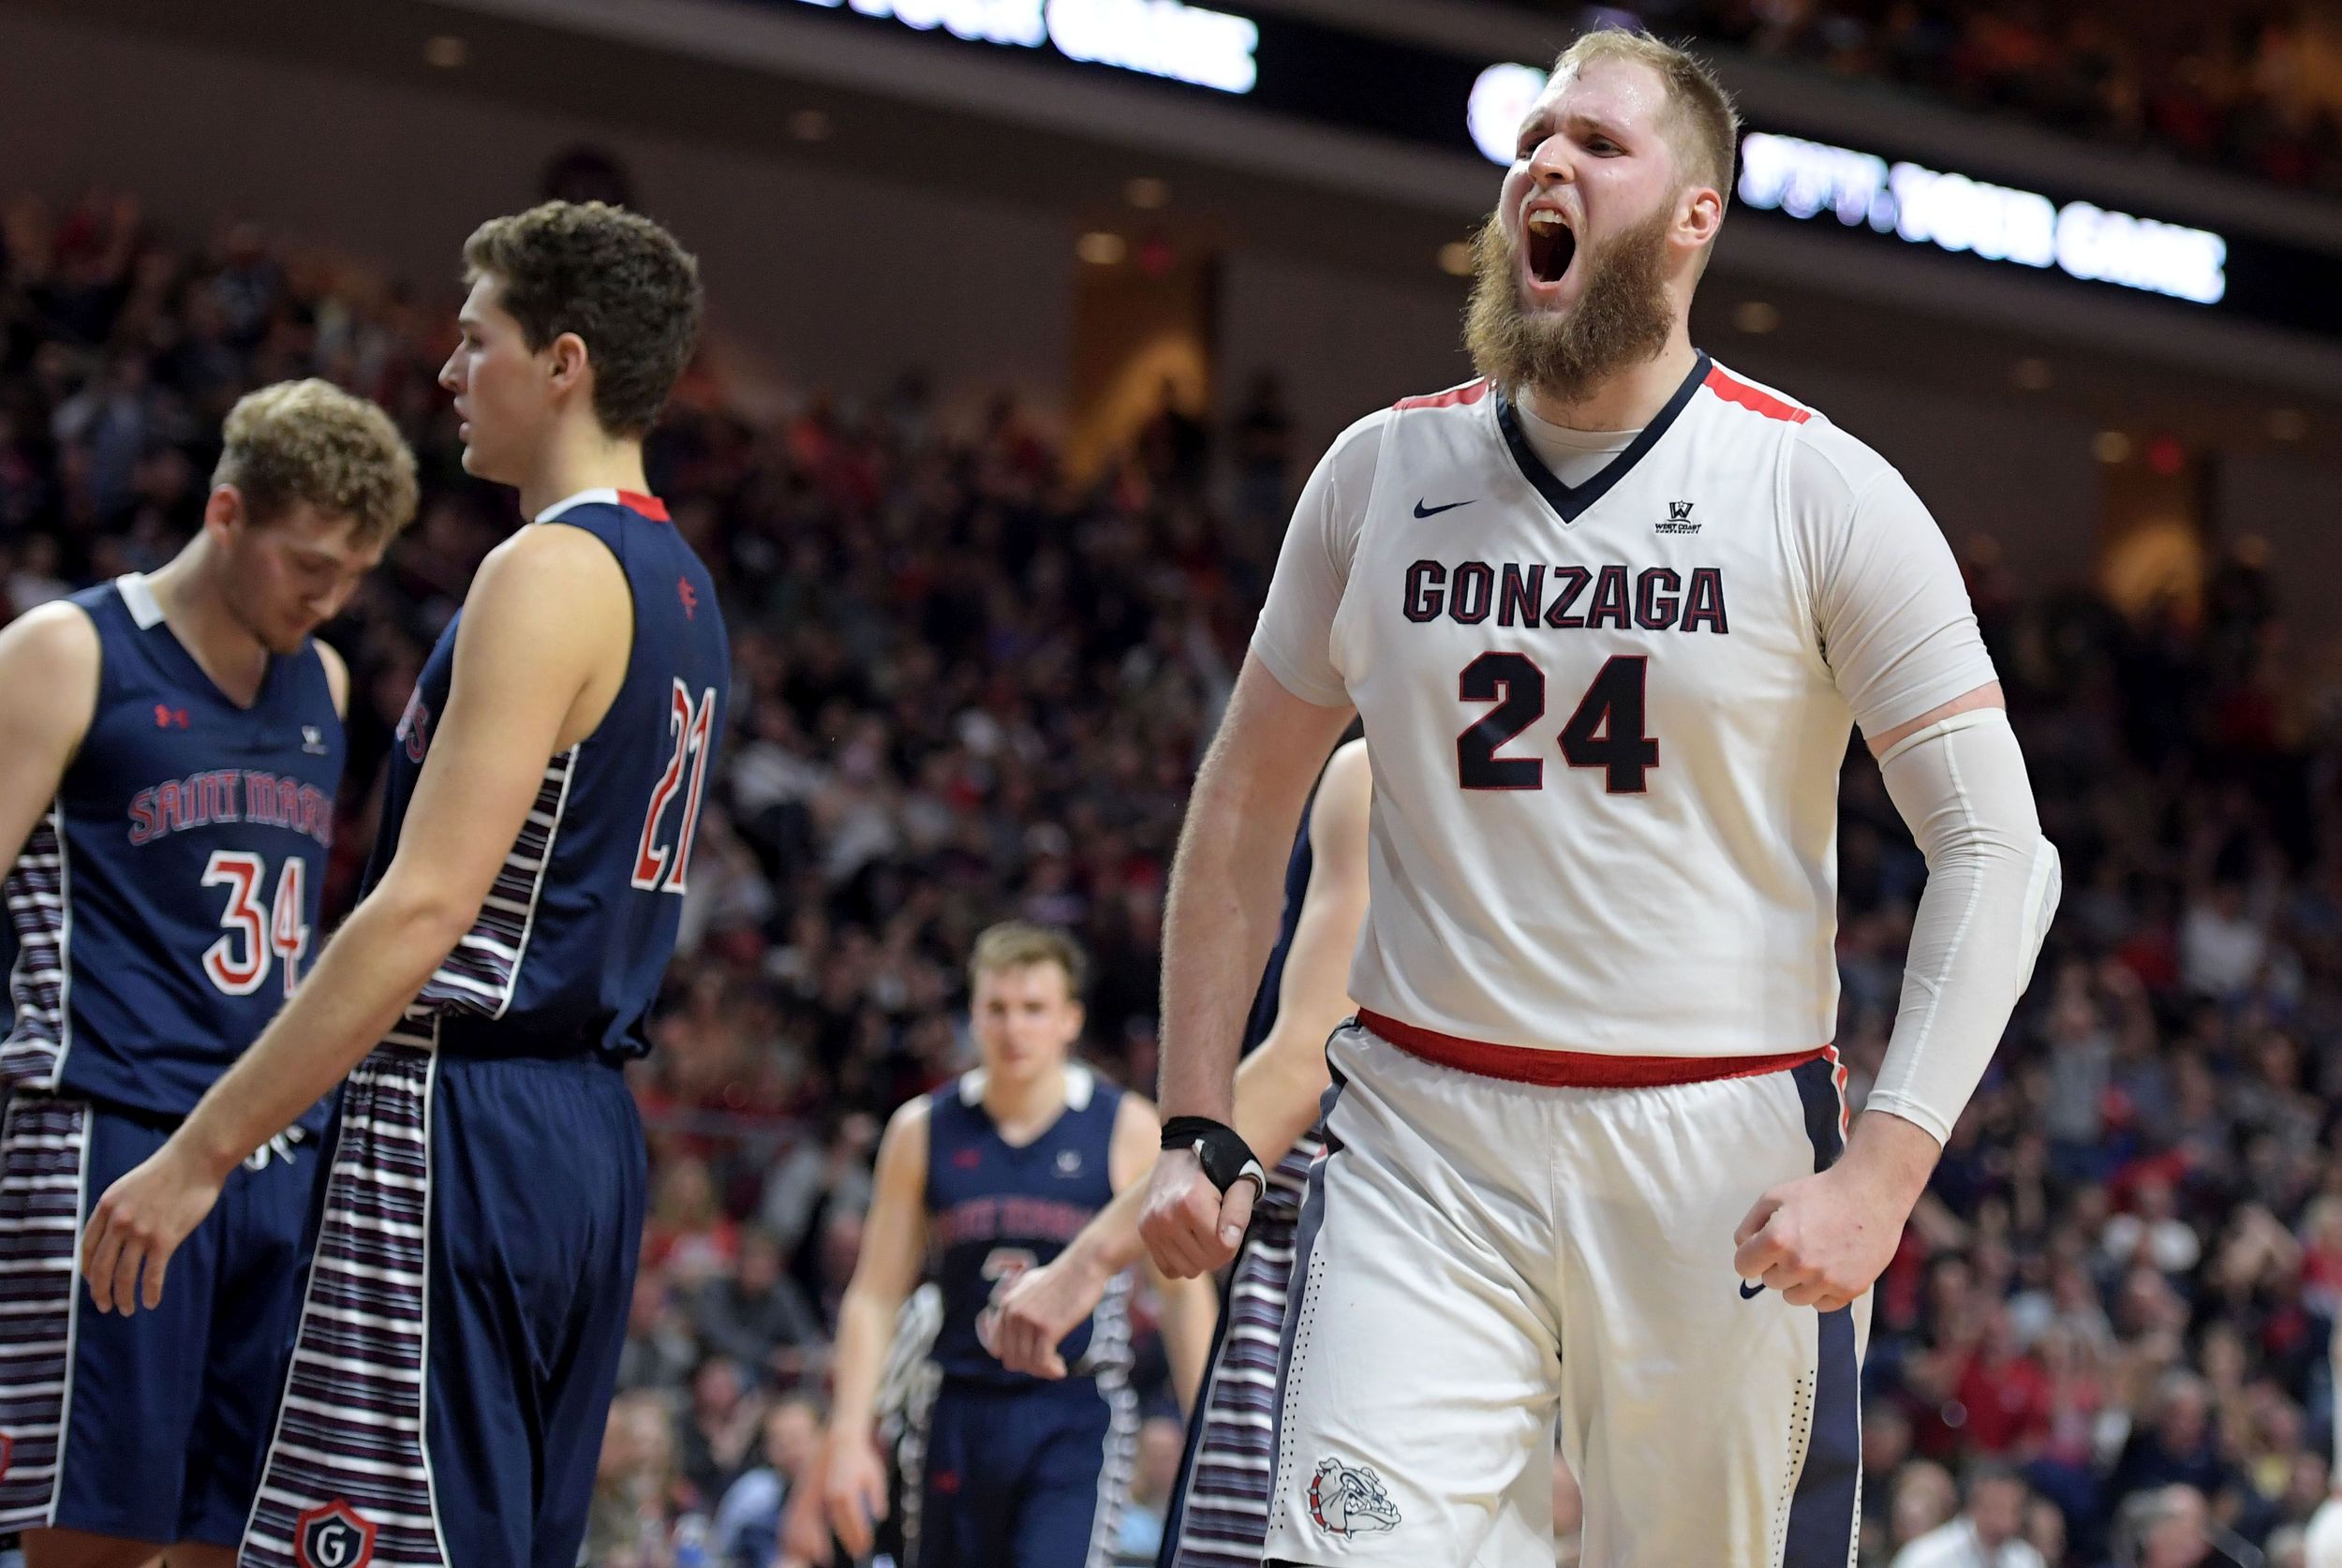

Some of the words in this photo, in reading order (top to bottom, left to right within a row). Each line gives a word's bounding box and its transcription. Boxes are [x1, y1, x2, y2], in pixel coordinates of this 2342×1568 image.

[1403, 559, 1729, 634] GONZAGA
[1457, 651, 1659, 793] 24
[127, 768, 242, 847] SAINT
[631, 676, 717, 895] 21
[200, 850, 310, 999] 34
[316, 1525, 347, 1568] G
